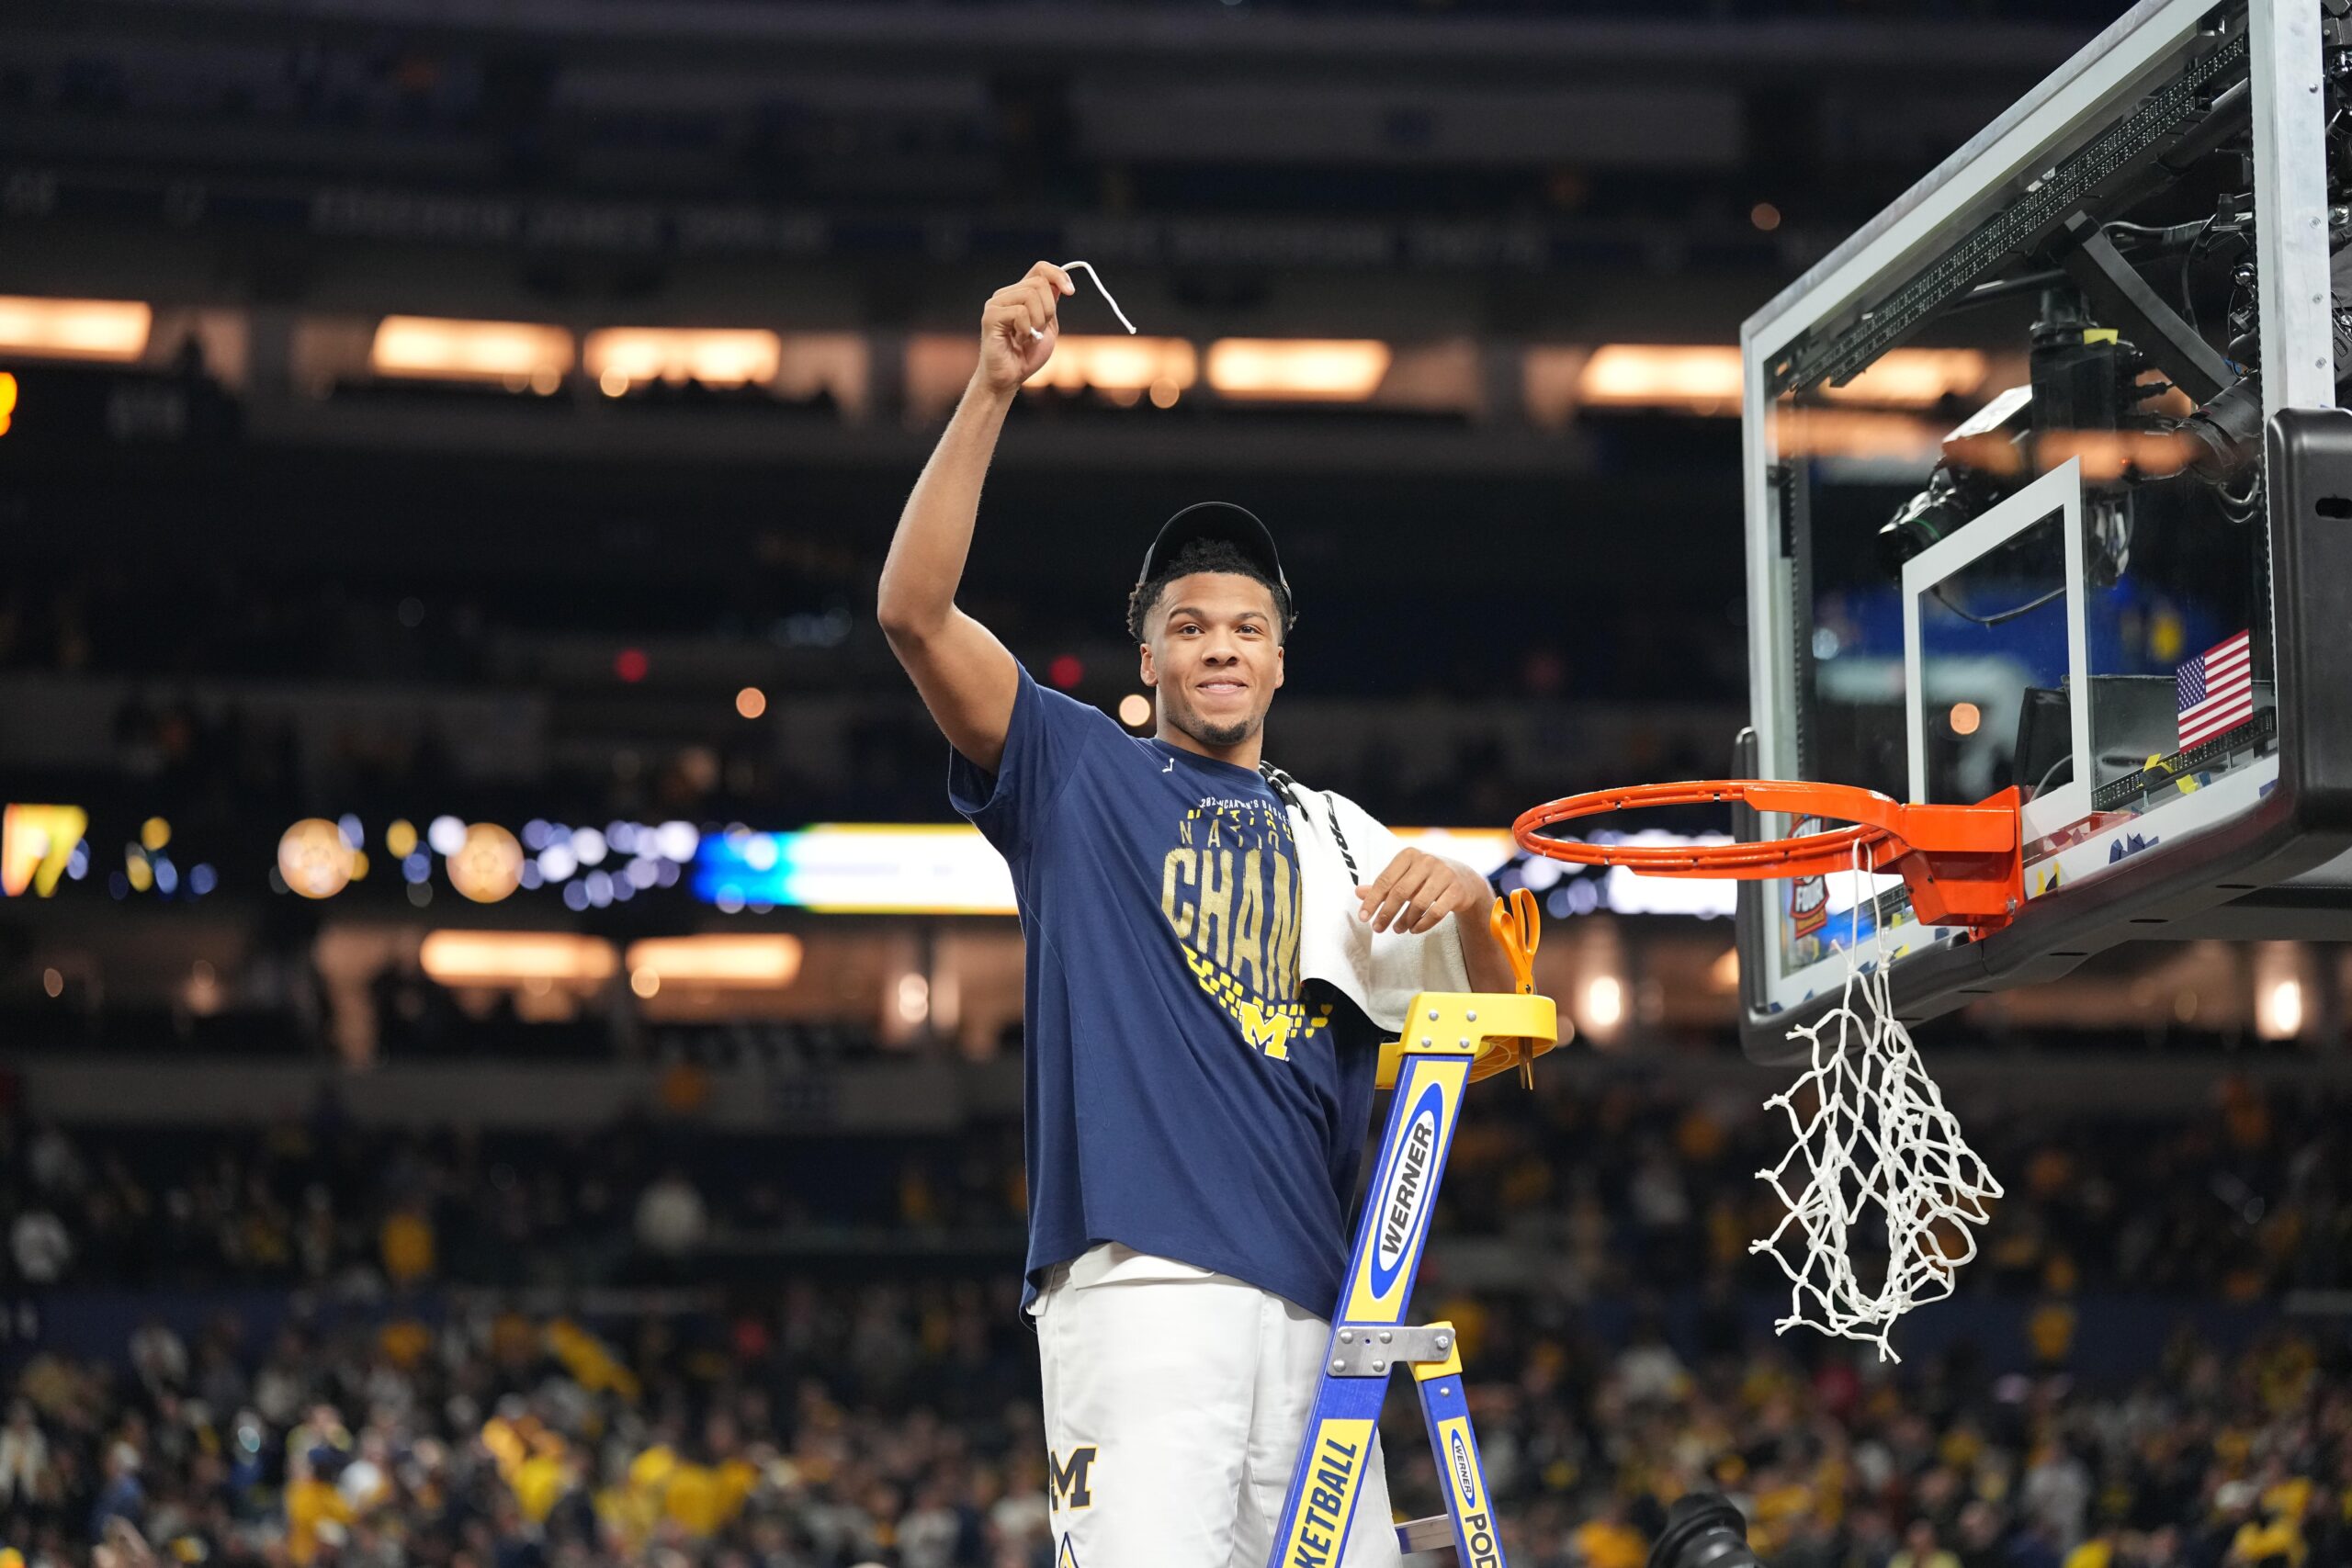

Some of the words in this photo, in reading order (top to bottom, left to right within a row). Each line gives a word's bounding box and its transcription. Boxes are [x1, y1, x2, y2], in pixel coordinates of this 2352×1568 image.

[1261, 799, 1291, 827] BASKE
[1239, 1000, 1292, 1060] M
[1382, 1122, 1433, 1255] WERNER
[1050, 1446, 1099, 1514] M
[1455, 1445, 1472, 1493] WERNER
[1294, 1438, 1358, 1568] KETBALL
